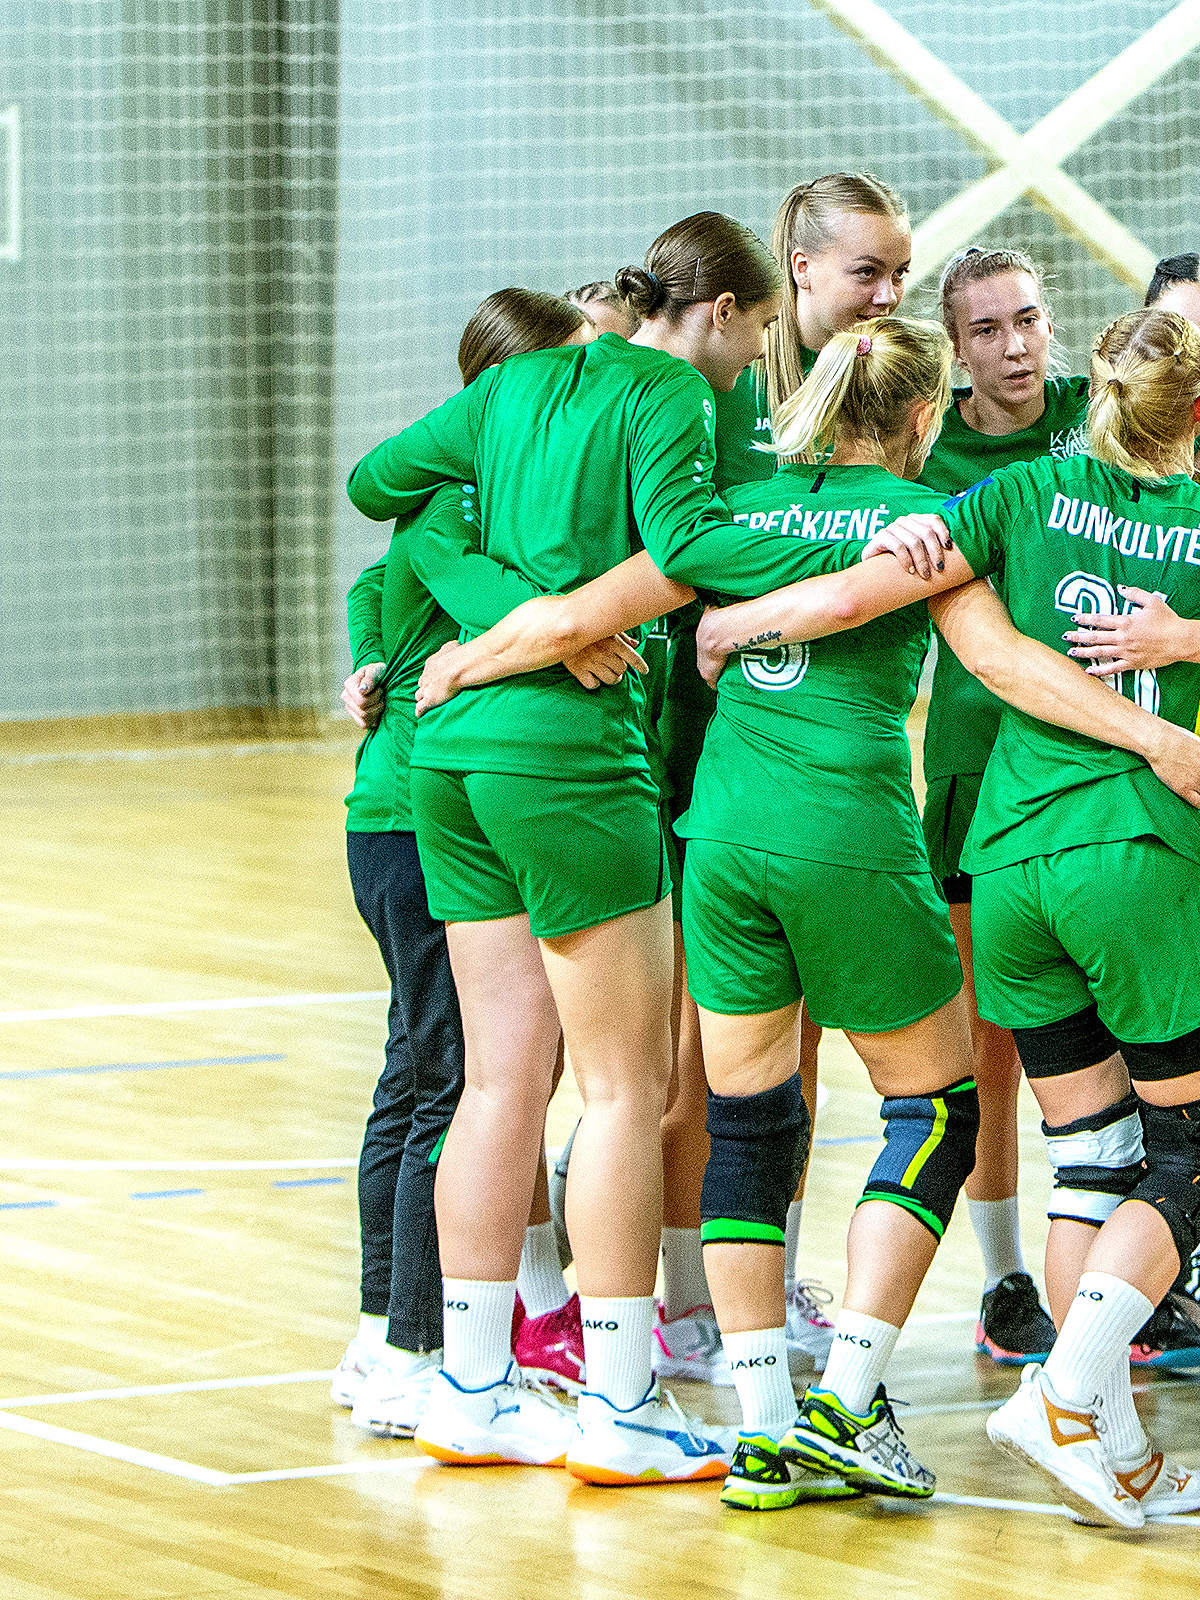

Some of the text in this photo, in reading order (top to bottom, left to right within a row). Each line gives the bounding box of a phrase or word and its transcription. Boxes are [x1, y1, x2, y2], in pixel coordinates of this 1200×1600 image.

[753, 417, 773, 431] JA
[1077, 1289, 1104, 1301] KO
[444, 1300, 469, 1312] KO
